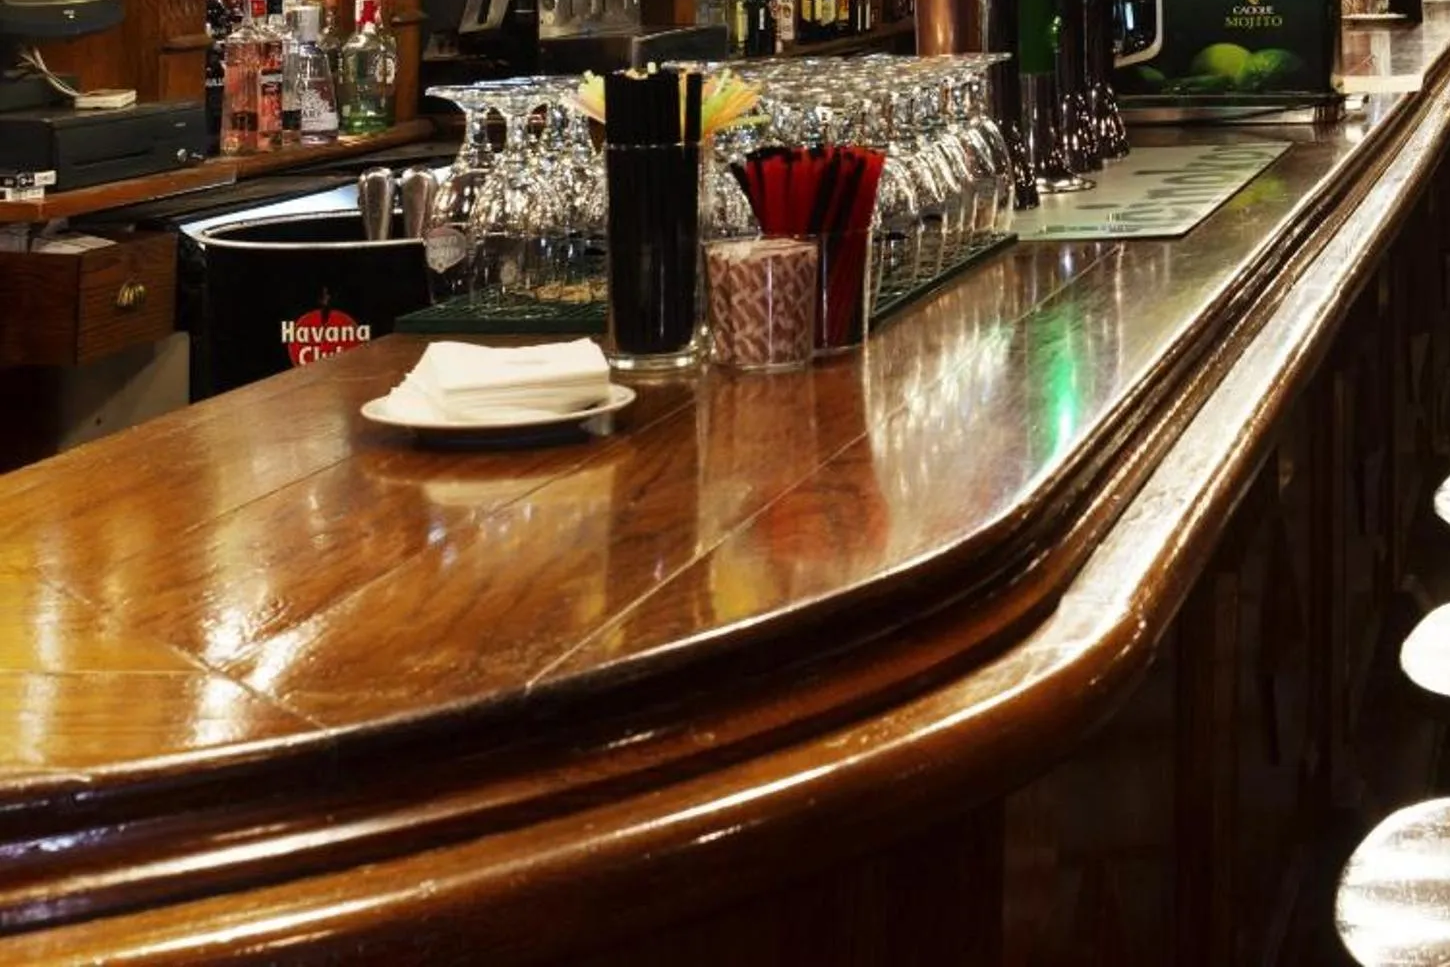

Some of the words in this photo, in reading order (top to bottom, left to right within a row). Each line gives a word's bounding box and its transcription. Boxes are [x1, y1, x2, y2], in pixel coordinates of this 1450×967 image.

[1224, 16, 1283, 29] MOJITO
[281, 320, 371, 343] Havana
[299, 346, 342, 366] Cl
